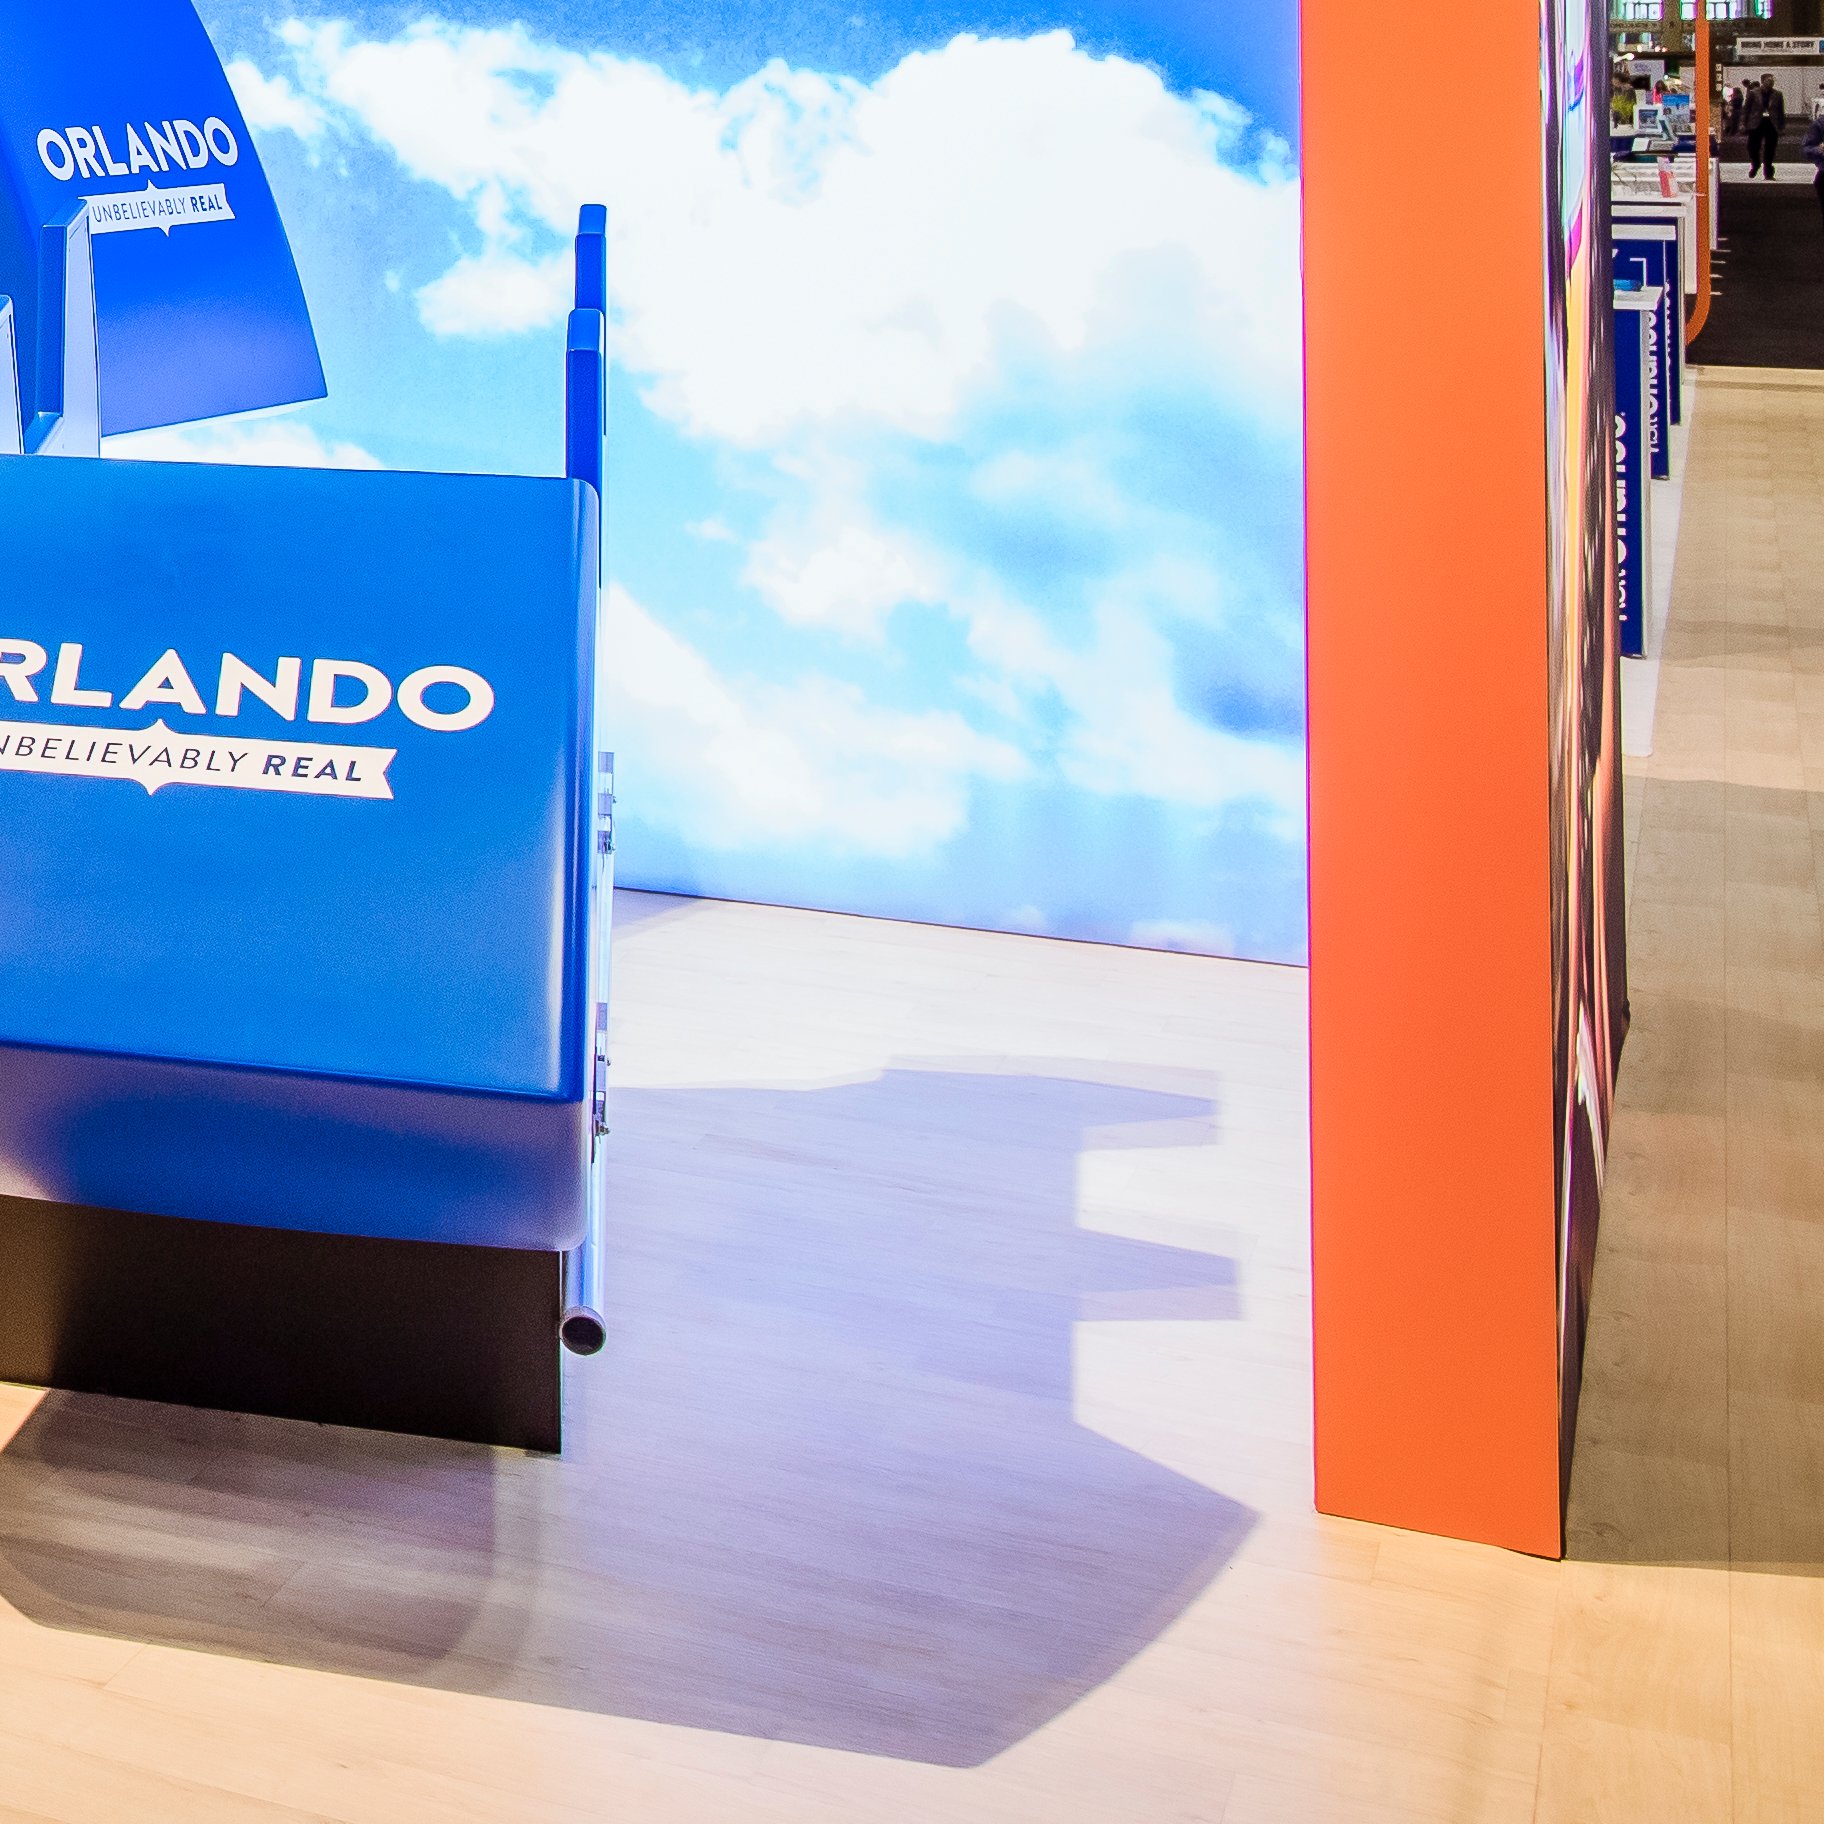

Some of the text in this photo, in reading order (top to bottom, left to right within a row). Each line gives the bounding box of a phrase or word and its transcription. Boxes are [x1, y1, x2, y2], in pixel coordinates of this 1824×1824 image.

[36, 116, 239, 181] ORLANDO
[92, 194, 223, 223] UNBELIEVABLY REAL
[262, 754, 363, 782] REAL
